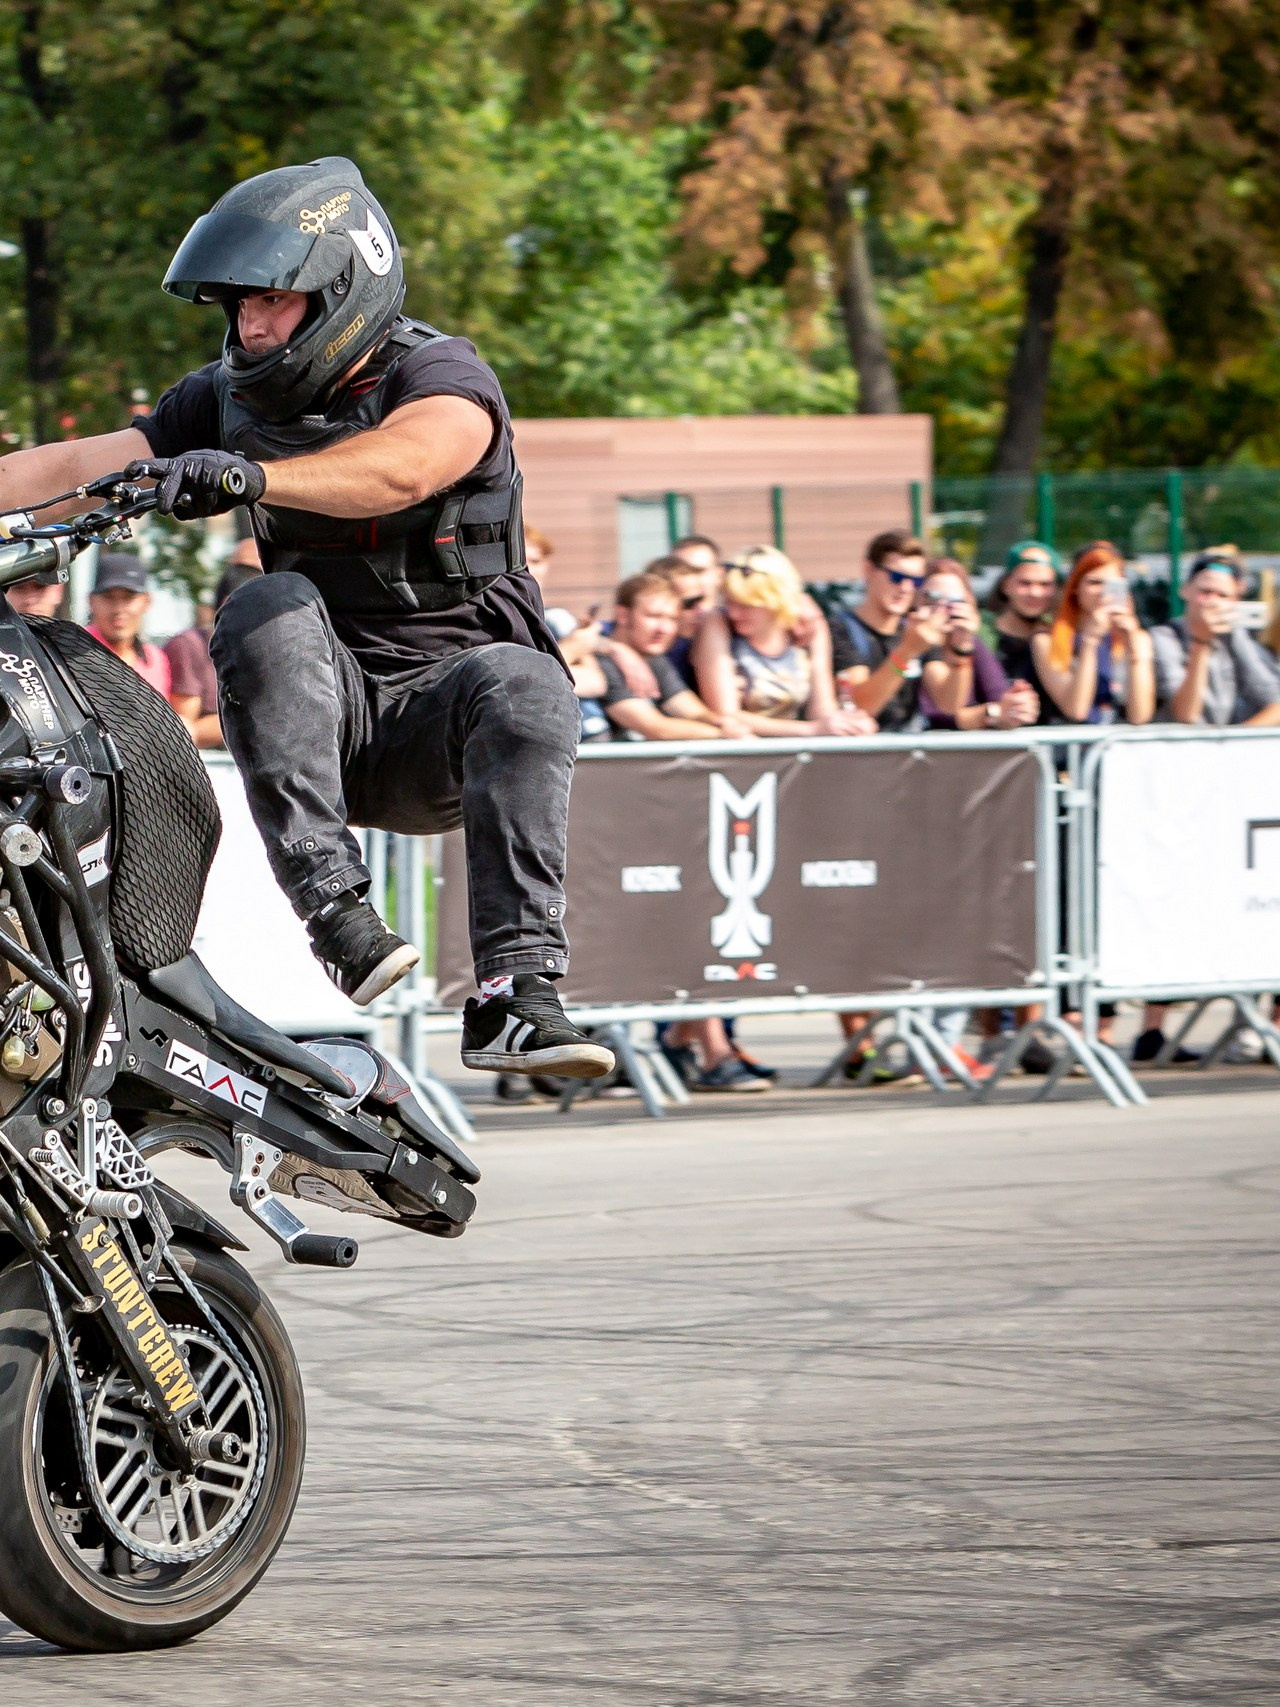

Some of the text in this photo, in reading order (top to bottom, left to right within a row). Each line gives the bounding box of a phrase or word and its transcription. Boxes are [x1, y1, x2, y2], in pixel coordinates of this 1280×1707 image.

[326, 203, 350, 221] МОТО
[370, 236, 385, 259] 5
[17, 678, 40, 710] МОТО
[27, 677, 55, 730] ПАРТНЕР
[81, 1222, 199, 1412] STUNTCREW
